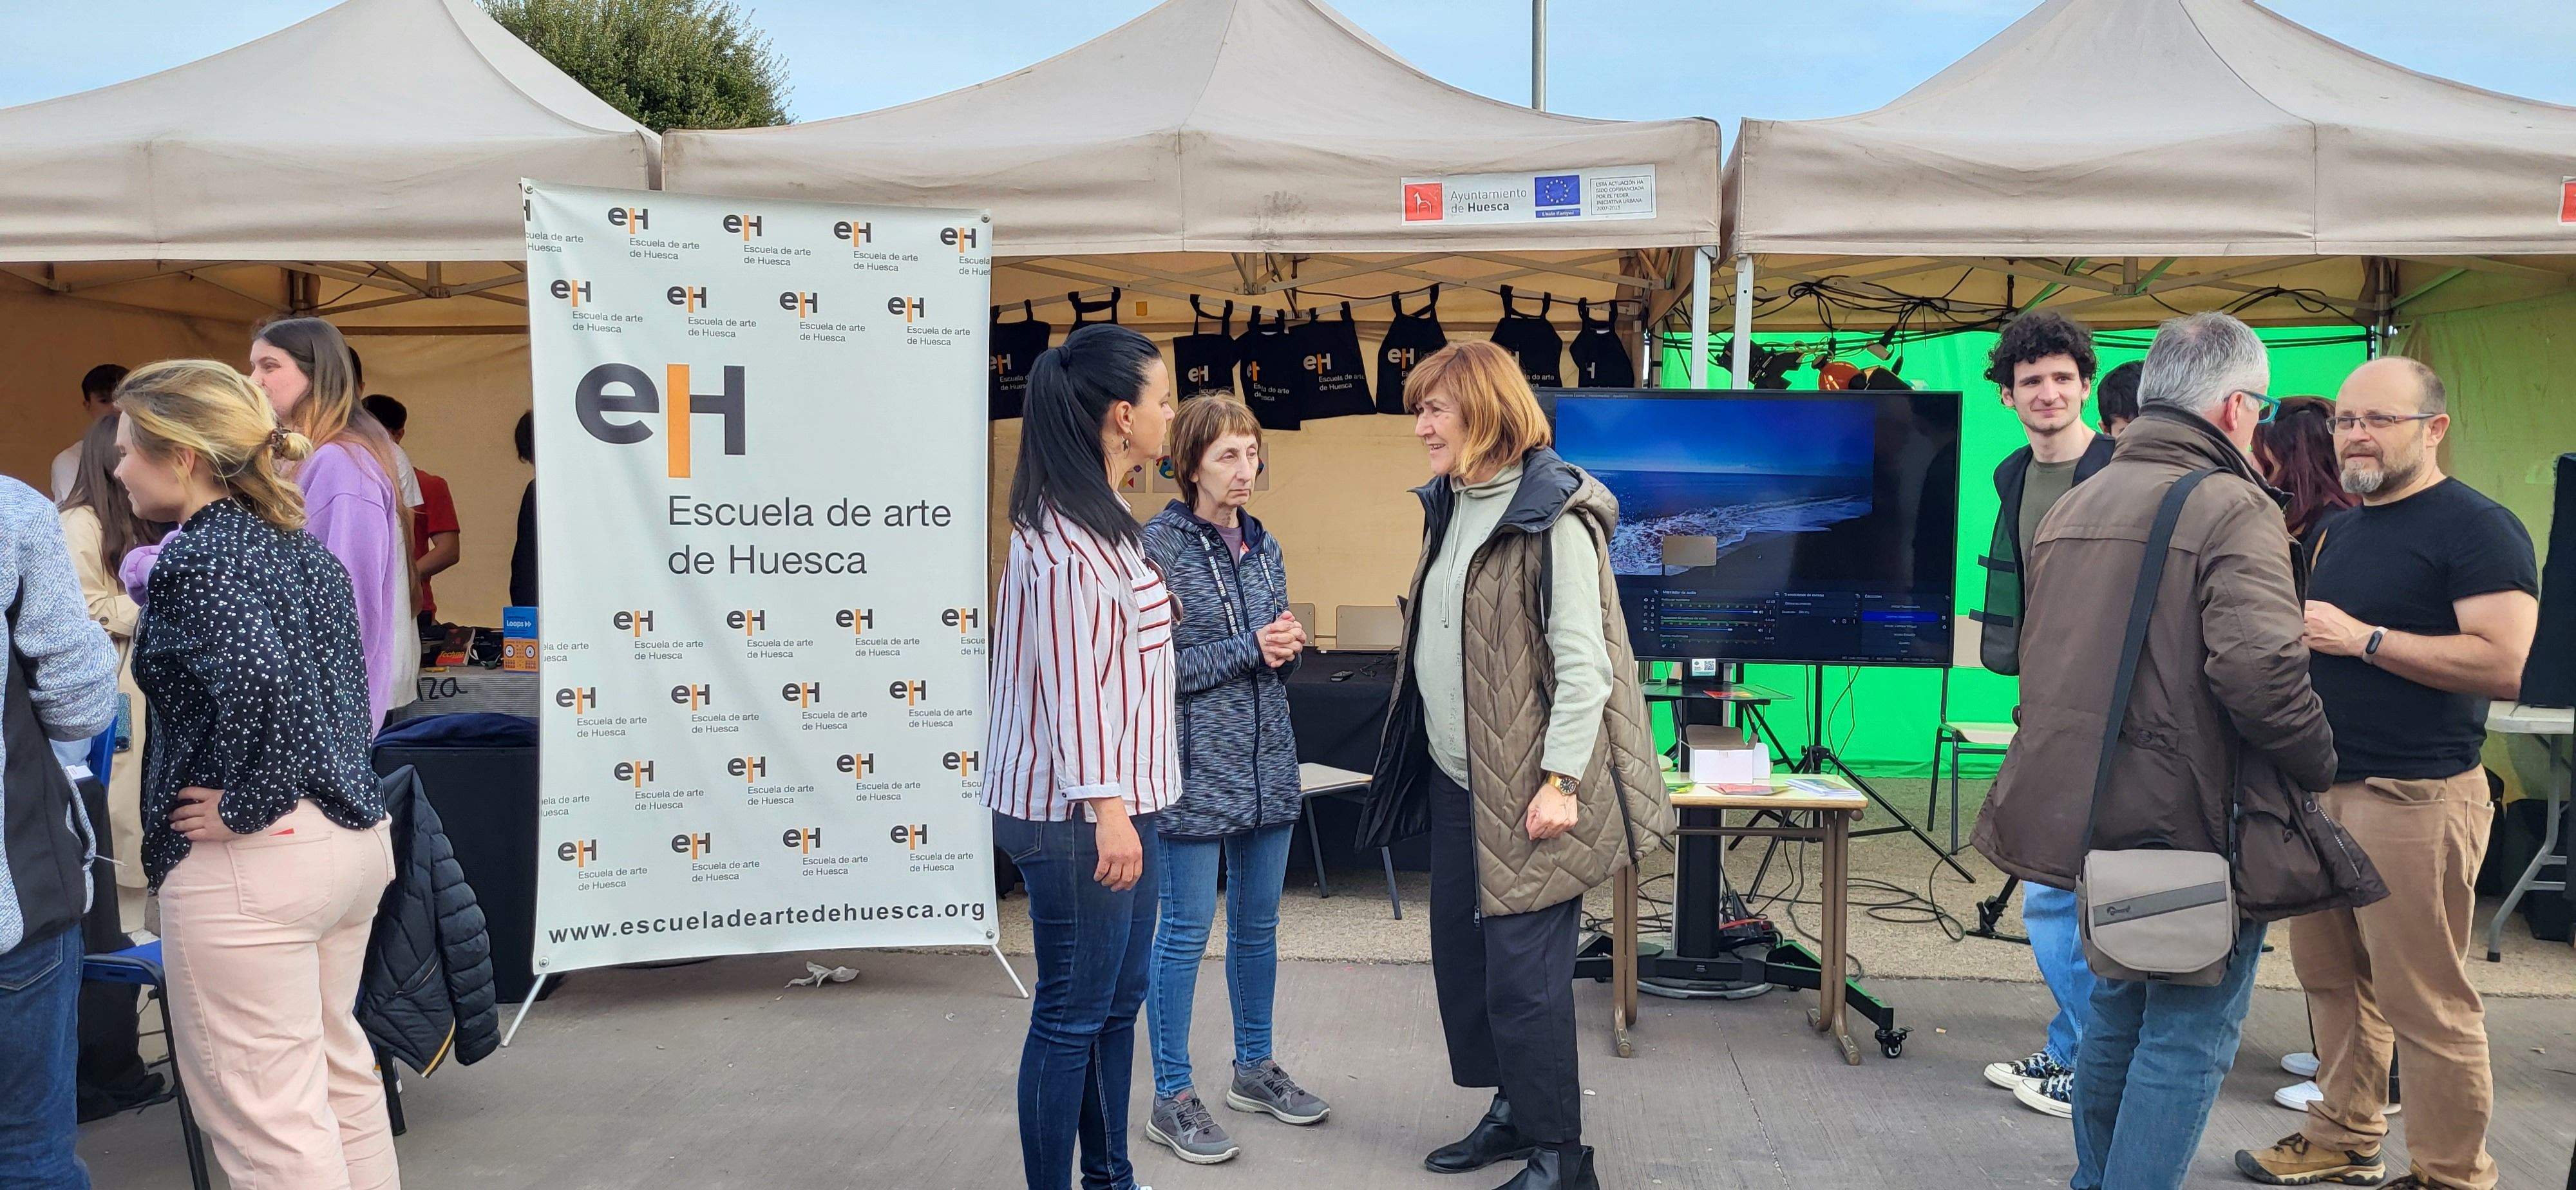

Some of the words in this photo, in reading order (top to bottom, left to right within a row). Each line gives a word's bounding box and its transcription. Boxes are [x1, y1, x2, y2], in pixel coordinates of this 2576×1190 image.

[1451, 188, 1526, 203] Ayuntamiento
[1451, 203, 1464, 213] de
[1468, 202, 1510, 212] Huesca
[526, 231, 548, 240] cuela
[551, 233, 562, 241] de
[630, 238, 665, 247] Escuela
[527, 243, 562, 252] Huesca
[744, 245, 778, 254] Escuela
[644, 250, 678, 260] Huesca
[854, 251, 886, 260] Escuela
[758, 257, 790, 266] Huesca
[959, 256, 990, 265] Escuela
[867, 263, 898, 272] Huesca
[573, 311, 608, 323] Escuela
[573, 322, 584, 330] de
[587, 323, 621, 333] Huesca
[800, 322, 833, 330] Escuela
[670, 496, 813, 526] Escuela
[827, 498, 871, 527] de
[884, 500, 951, 527] arte
[668, 545, 714, 574] de
[730, 545, 867, 574] Huesca
[1209, 556, 1217, 569] HEART
[1217, 580, 1226, 597] FOLLOW
[1224, 601, 1233, 616] HEART
[506, 619, 524, 628] Loops
[672, 640, 684, 648] de
[856, 638, 888, 646] Escuela
[961, 636, 985, 645] Escue
[571, 641, 589, 650] arte
[692, 713, 726, 722] Escuela
[748, 786, 781, 795] Escuela
[542, 808, 569, 817] uesca
[578, 869, 612, 879] Escuela
[592, 881, 627, 889] Huesca
[549, 902, 985, 944] www.escueladeartedehuesca.org
